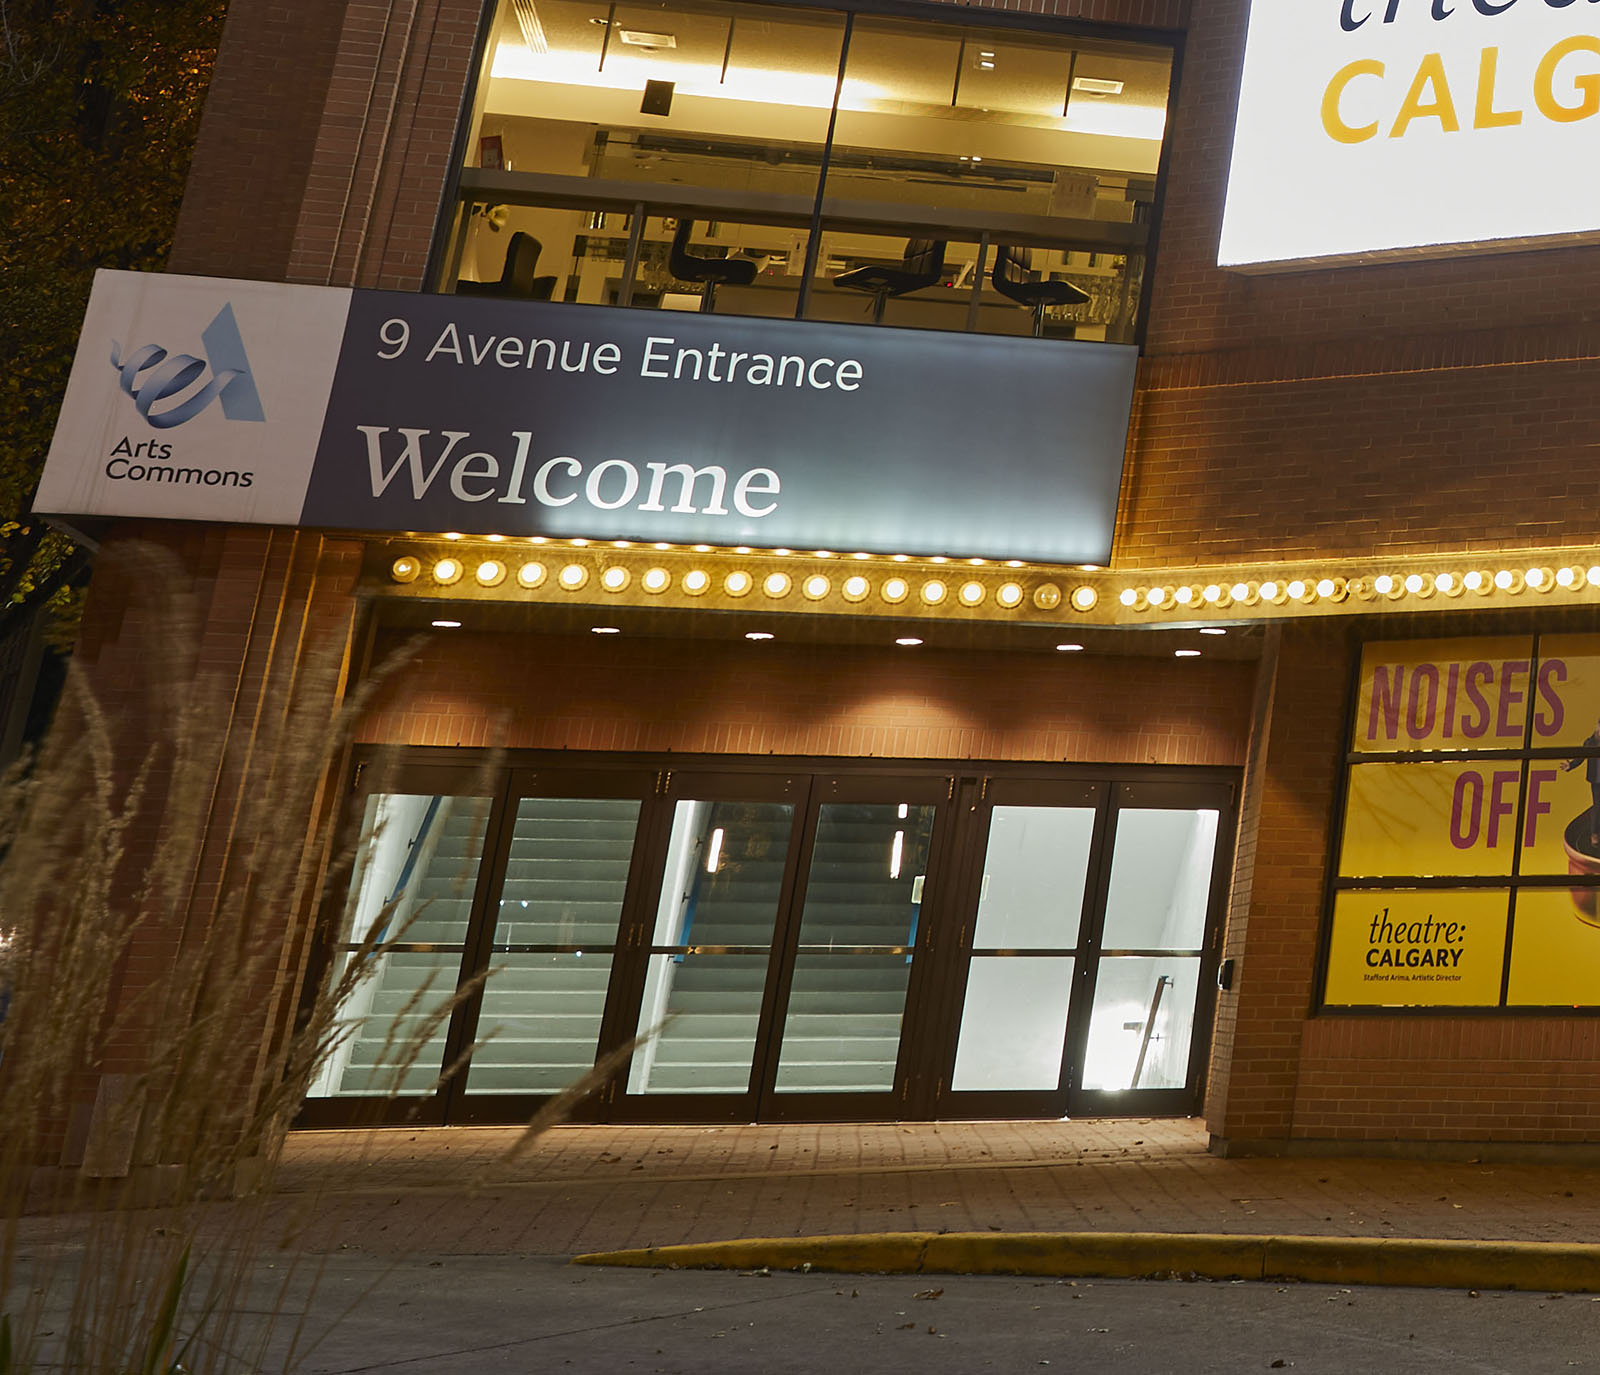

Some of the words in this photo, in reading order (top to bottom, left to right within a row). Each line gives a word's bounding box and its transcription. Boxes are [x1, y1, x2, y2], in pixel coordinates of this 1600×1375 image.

[376, 318, 411, 360] 9
[425, 322, 622, 375] Avenue
[640, 336, 864, 392] Entrance
[105, 458, 254, 487] Commons
[110, 435, 173, 460] Arts
[357, 424, 781, 518] Welcome
[1367, 658, 1568, 740] NOISES
[1450, 770, 1557, 850] OFF
[1369, 907, 1466, 944] theatre:
[1366, 948, 1464, 967] CALGARY
